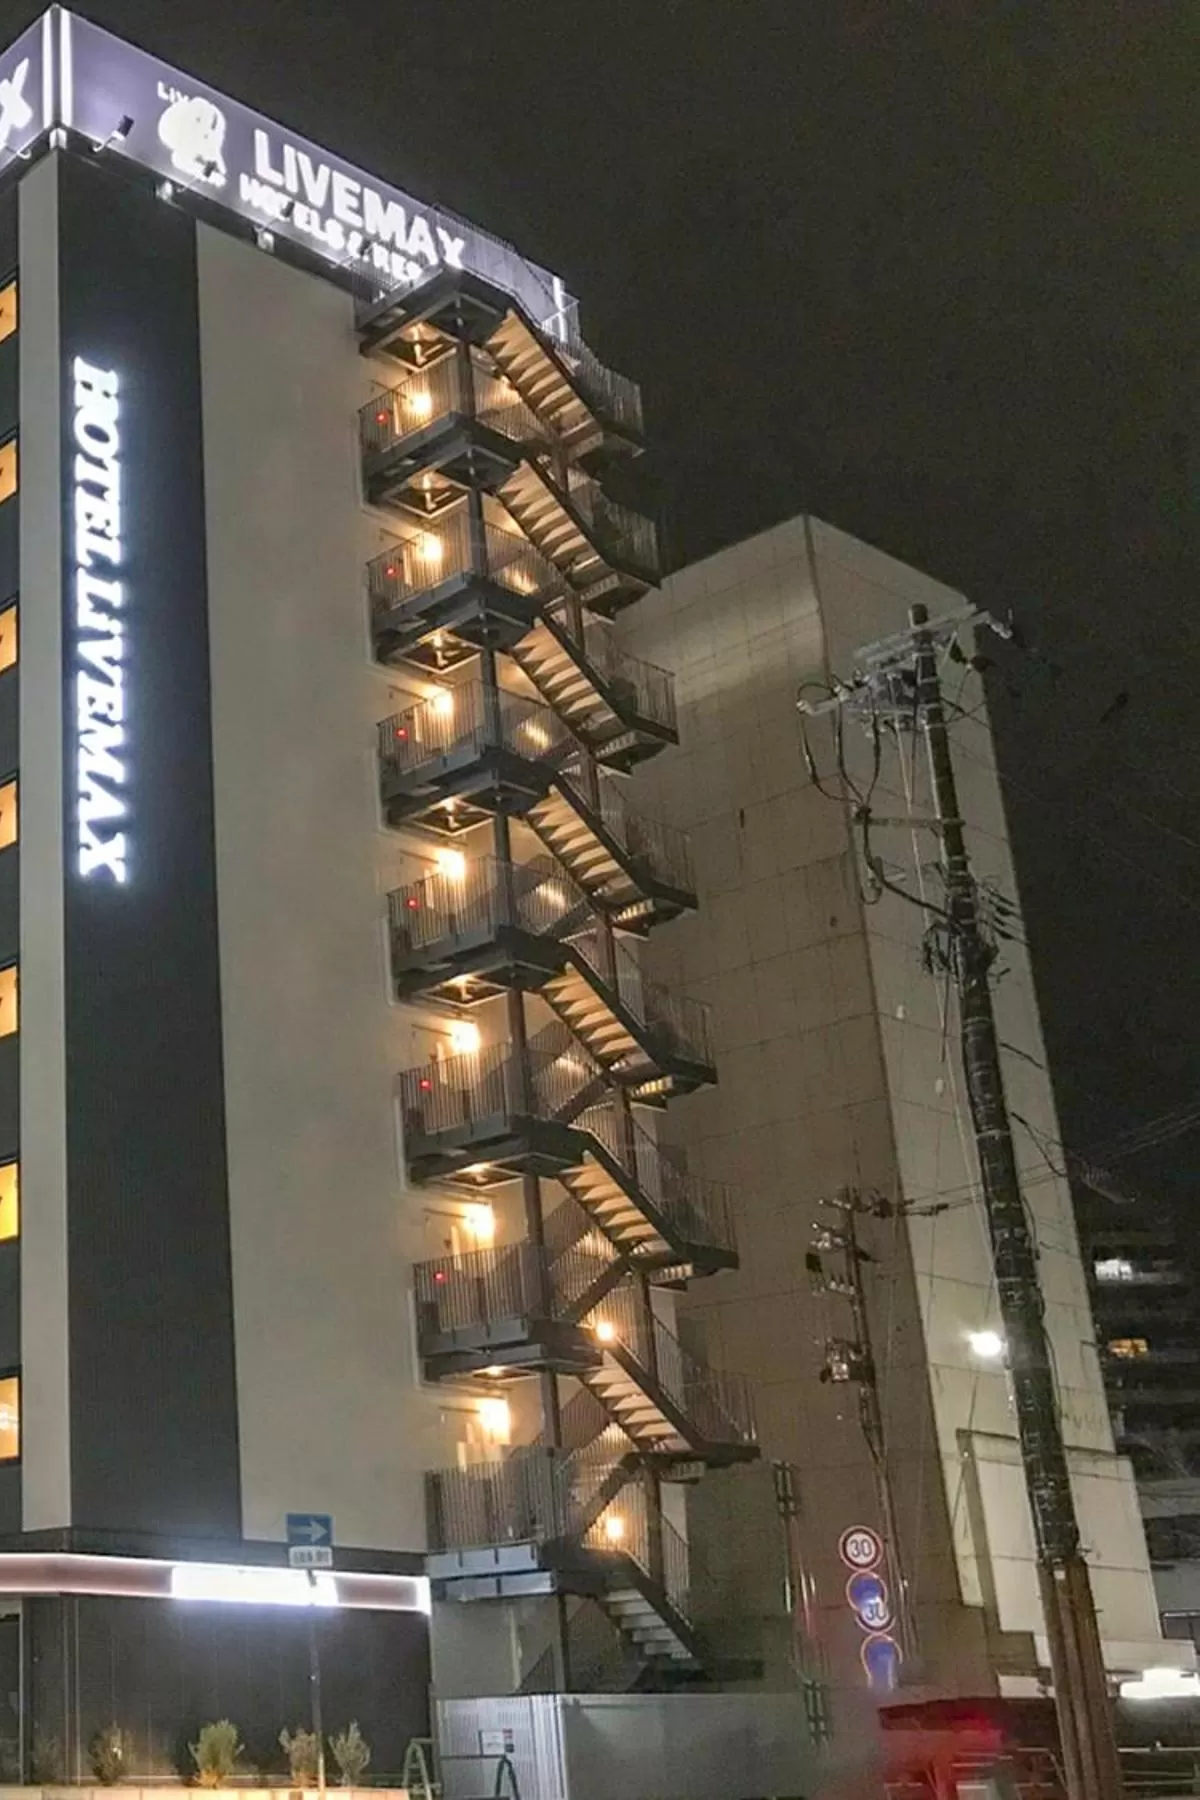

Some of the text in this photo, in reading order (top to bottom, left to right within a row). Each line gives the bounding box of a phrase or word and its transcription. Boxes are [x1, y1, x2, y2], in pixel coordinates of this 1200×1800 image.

[73, 356, 126, 884] HOTEL LIVEMAX
[850, 1539, 872, 1557] 30
